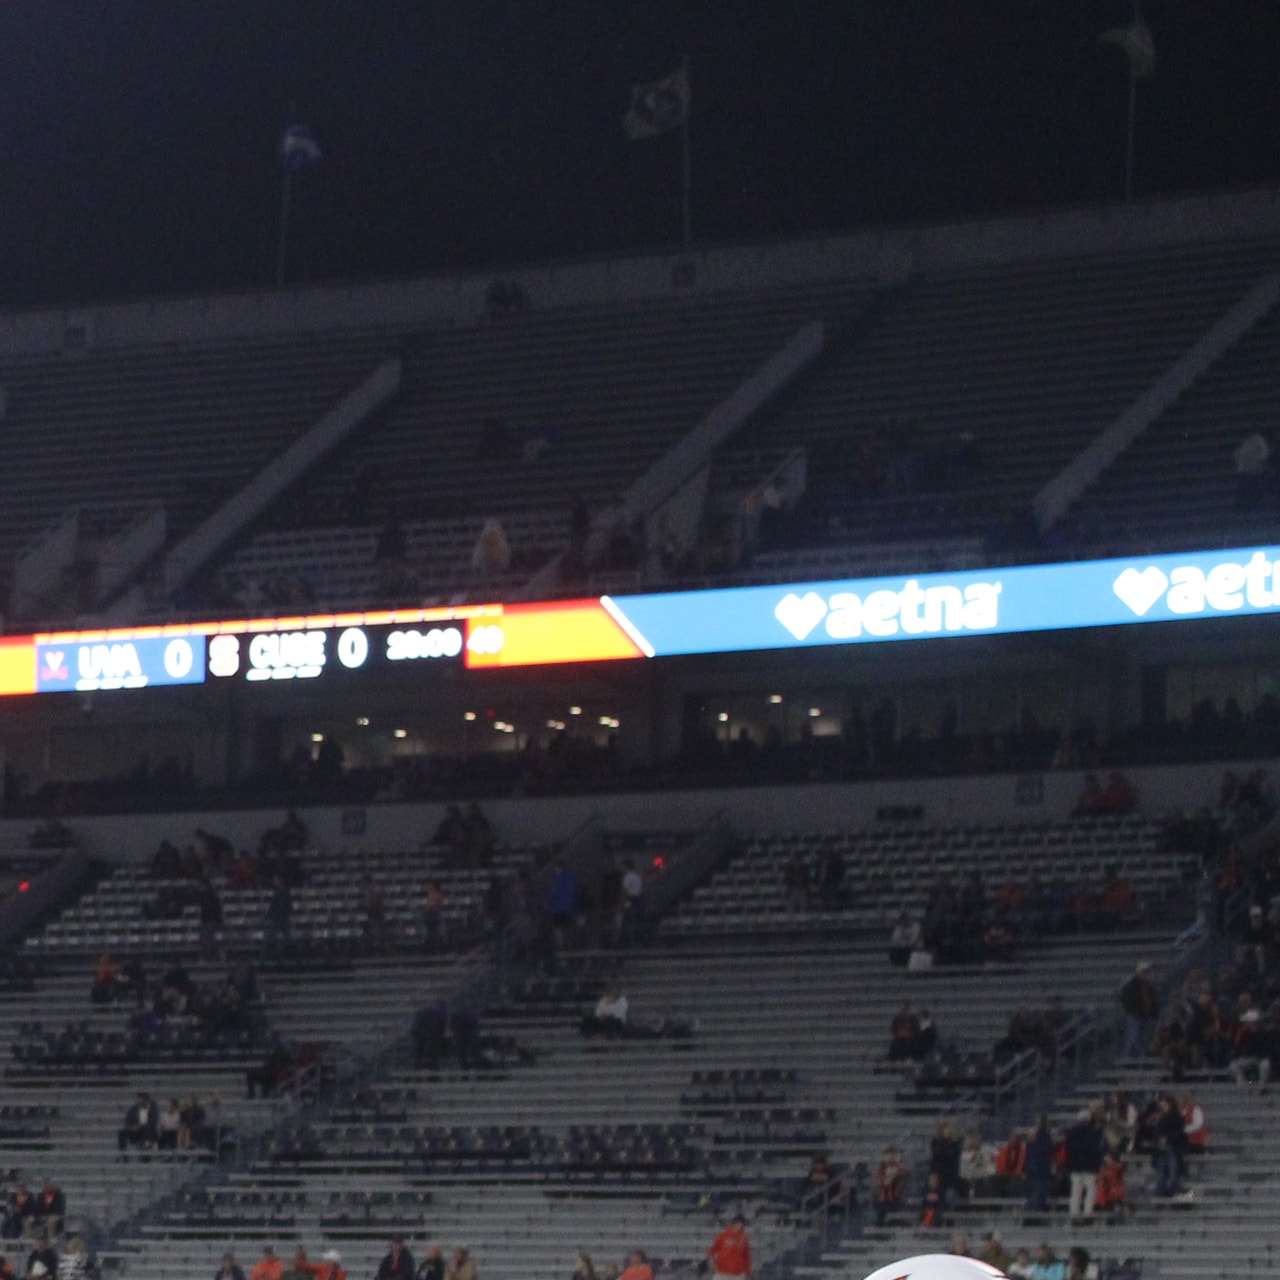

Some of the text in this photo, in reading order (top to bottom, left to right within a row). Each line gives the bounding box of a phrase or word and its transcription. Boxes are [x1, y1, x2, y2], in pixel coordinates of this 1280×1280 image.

[826, 580, 1001, 638] aetna
[1167, 552, 1280, 614] aet
[77, 643, 141, 679] UVA
[165, 638, 192, 678] 0
[248, 631, 326, 668] CUSE
[338, 627, 368, 668] 0
